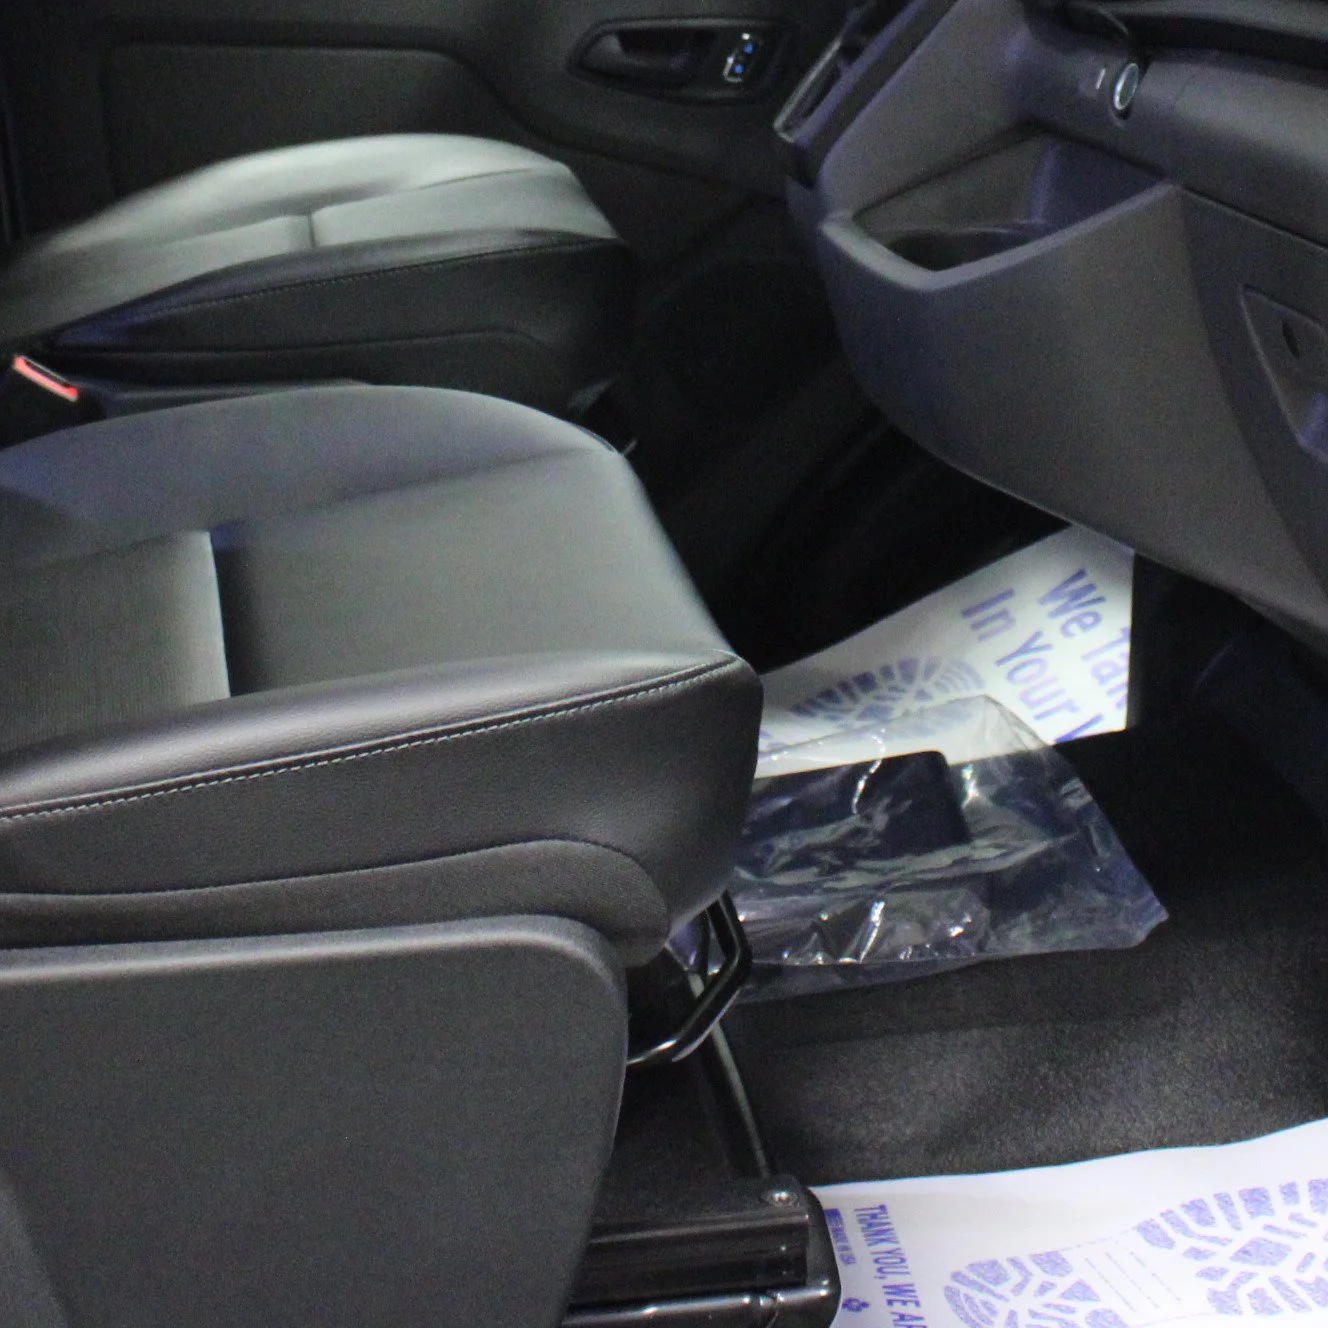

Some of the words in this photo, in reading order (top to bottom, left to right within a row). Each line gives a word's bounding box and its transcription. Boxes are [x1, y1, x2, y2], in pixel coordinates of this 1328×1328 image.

[1038, 568, 1106, 639] We
[960, 588, 1017, 642] In
[994, 630, 1080, 721] Your
[853, 1204, 900, 1247] THANK
[870, 1247, 911, 1280] YOU,
[882, 1283, 921, 1308] WE
